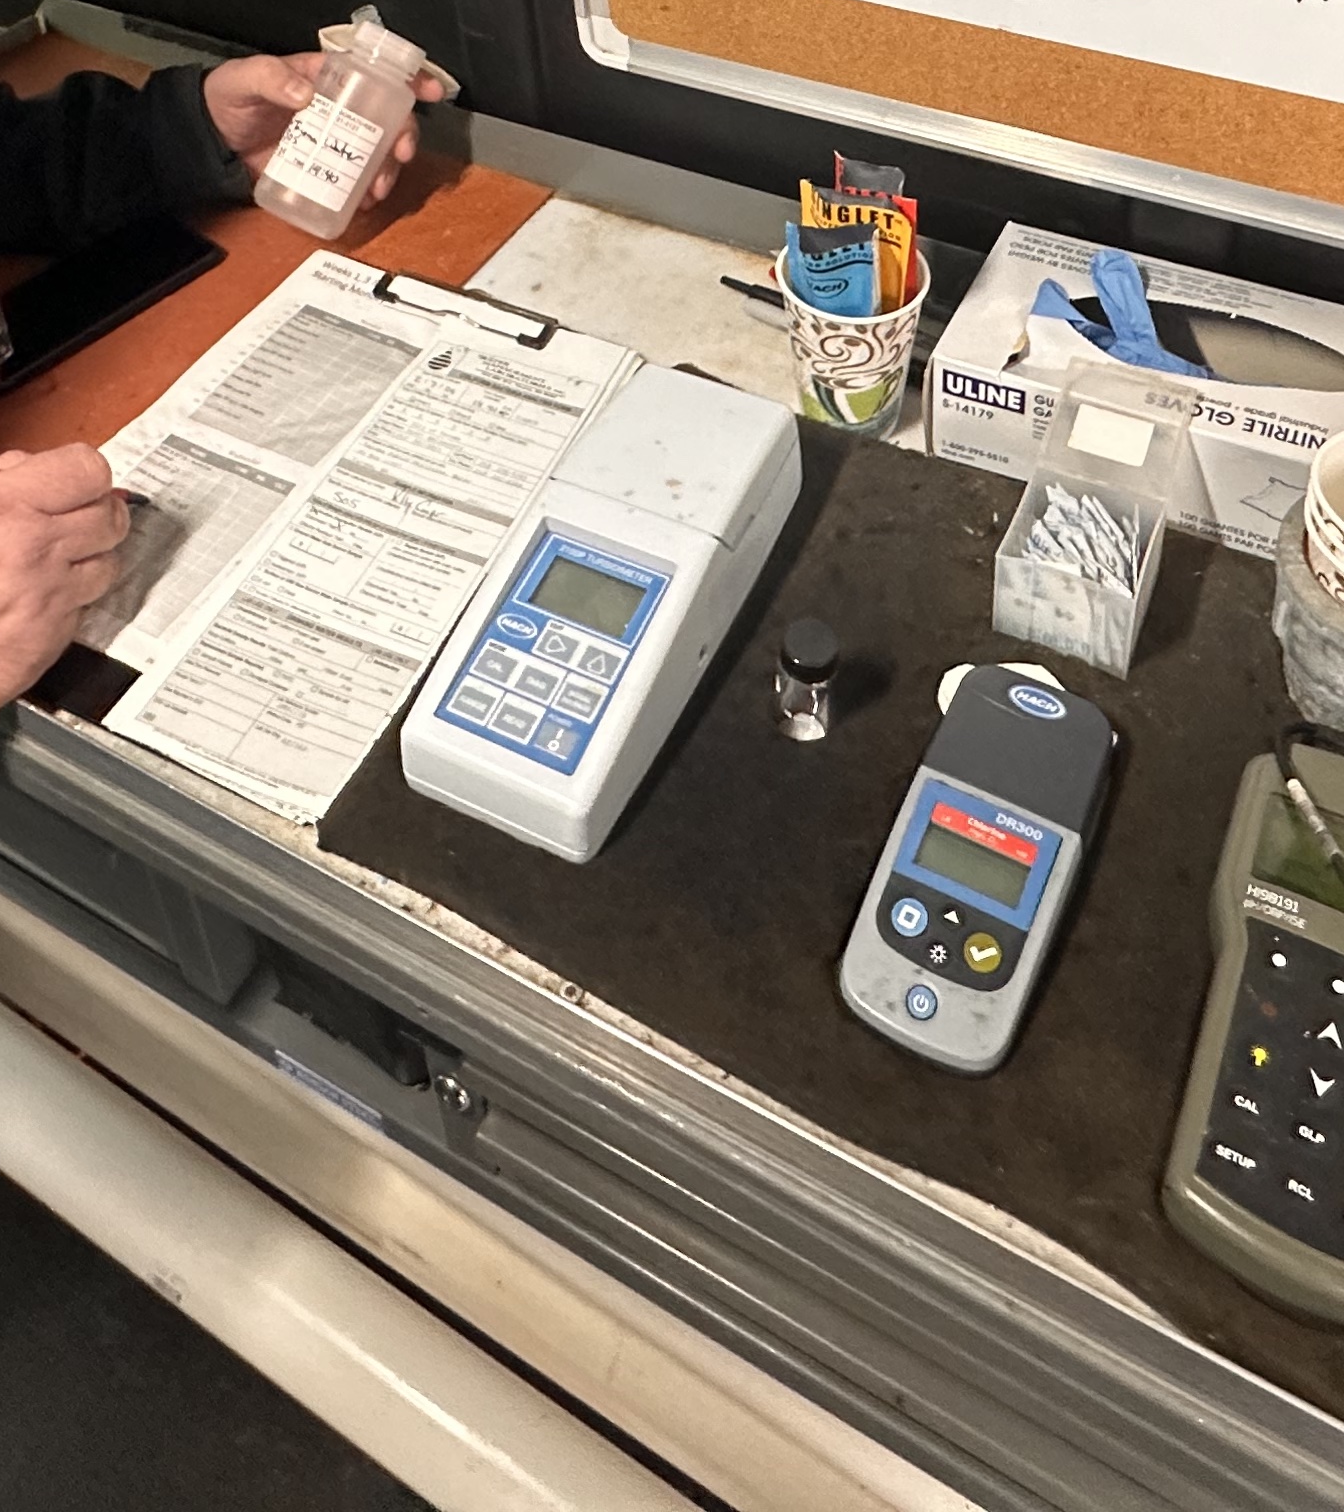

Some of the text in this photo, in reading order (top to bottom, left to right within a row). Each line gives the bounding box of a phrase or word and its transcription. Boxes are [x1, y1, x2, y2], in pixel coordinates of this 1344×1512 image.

[946, 373, 1022, 411] ULINE
[942, 398, 994, 420] S-14179
[1242, 417, 1328, 450] NITRILE
[1017, 691, 1058, 713] HACH
[994, 812, 1044, 841] DR300
[1234, 1095, 1260, 1116] CAL
[1215, 1144, 1257, 1169] SETUP
[1288, 1179, 1315, 1202] RCL
